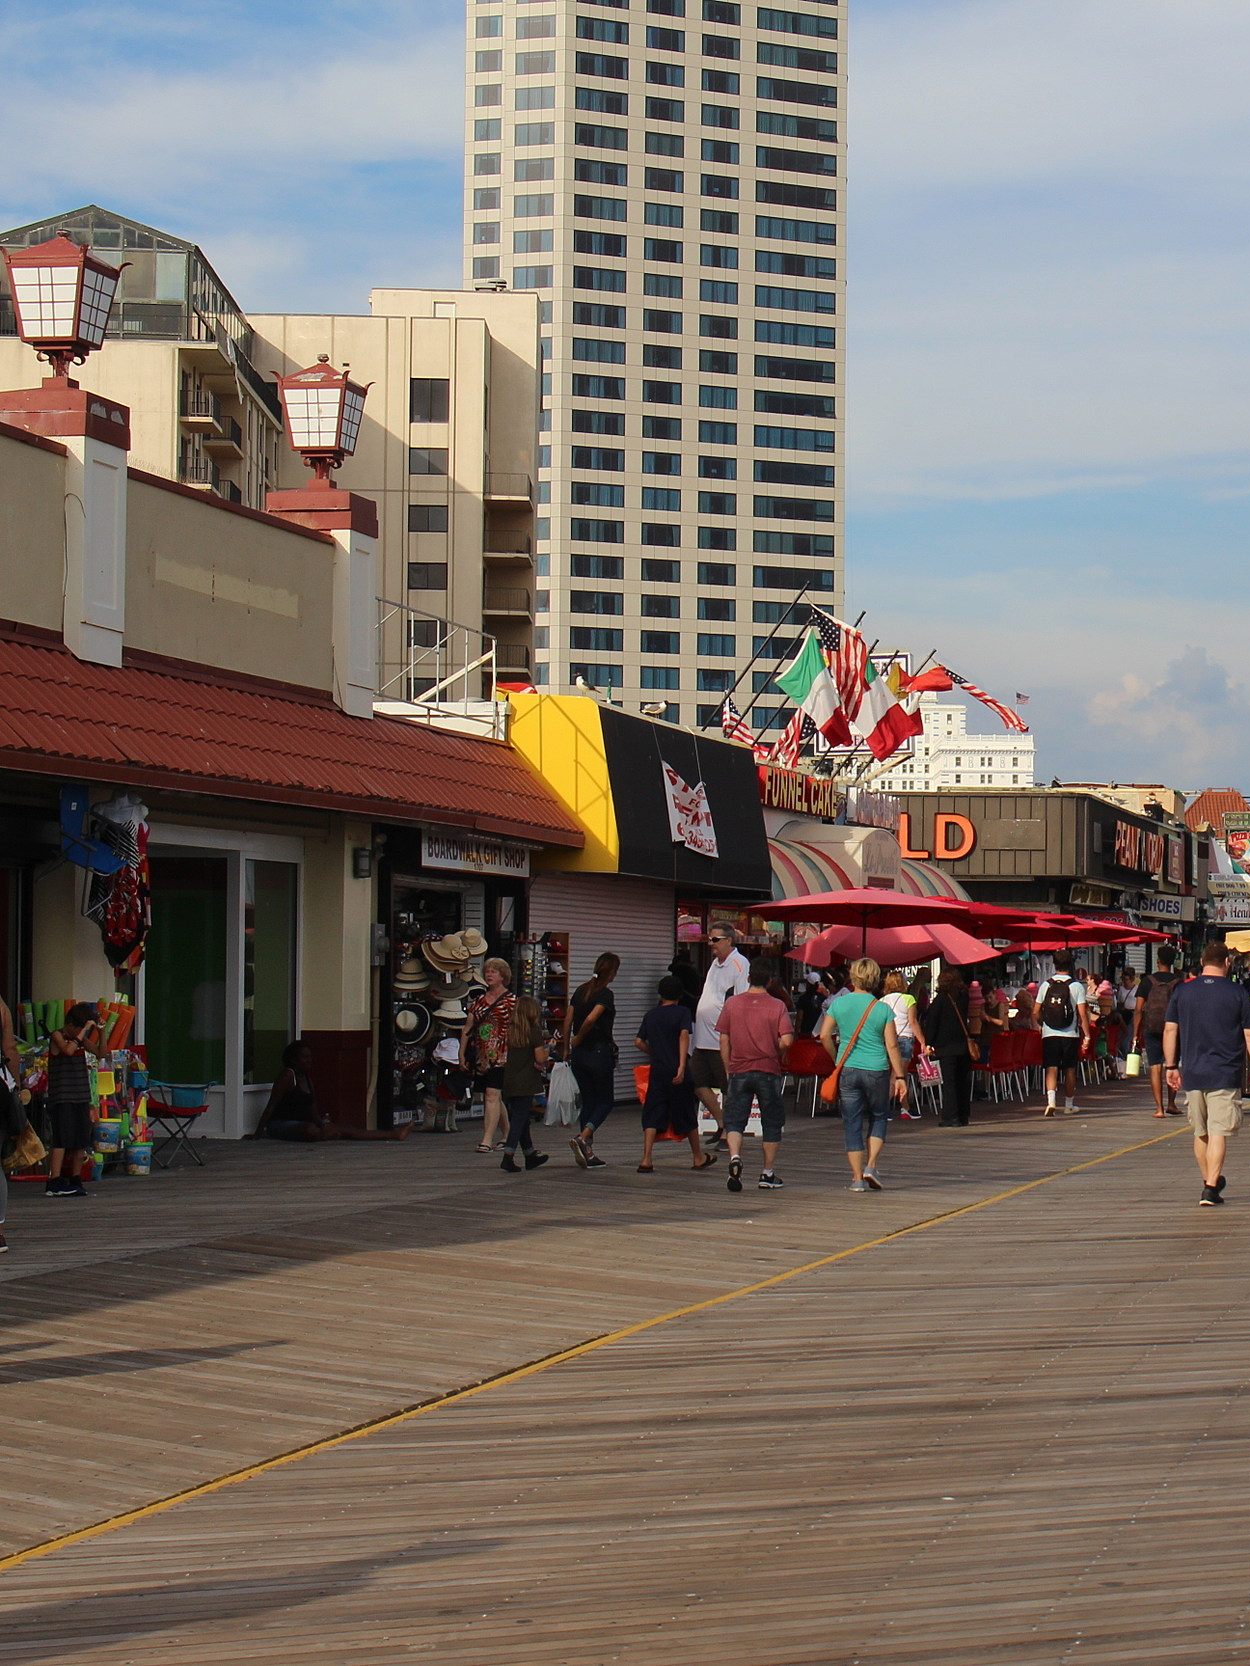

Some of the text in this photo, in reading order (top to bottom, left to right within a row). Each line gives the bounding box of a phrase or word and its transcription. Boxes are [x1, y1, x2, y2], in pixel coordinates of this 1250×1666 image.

[765, 768, 808, 809] FUNNEL
[811, 778, 837, 818] CAKE
[427, 836, 526, 868] BOARDWALK GIFT SHOP
[1142, 898, 1180, 914] SHOES
